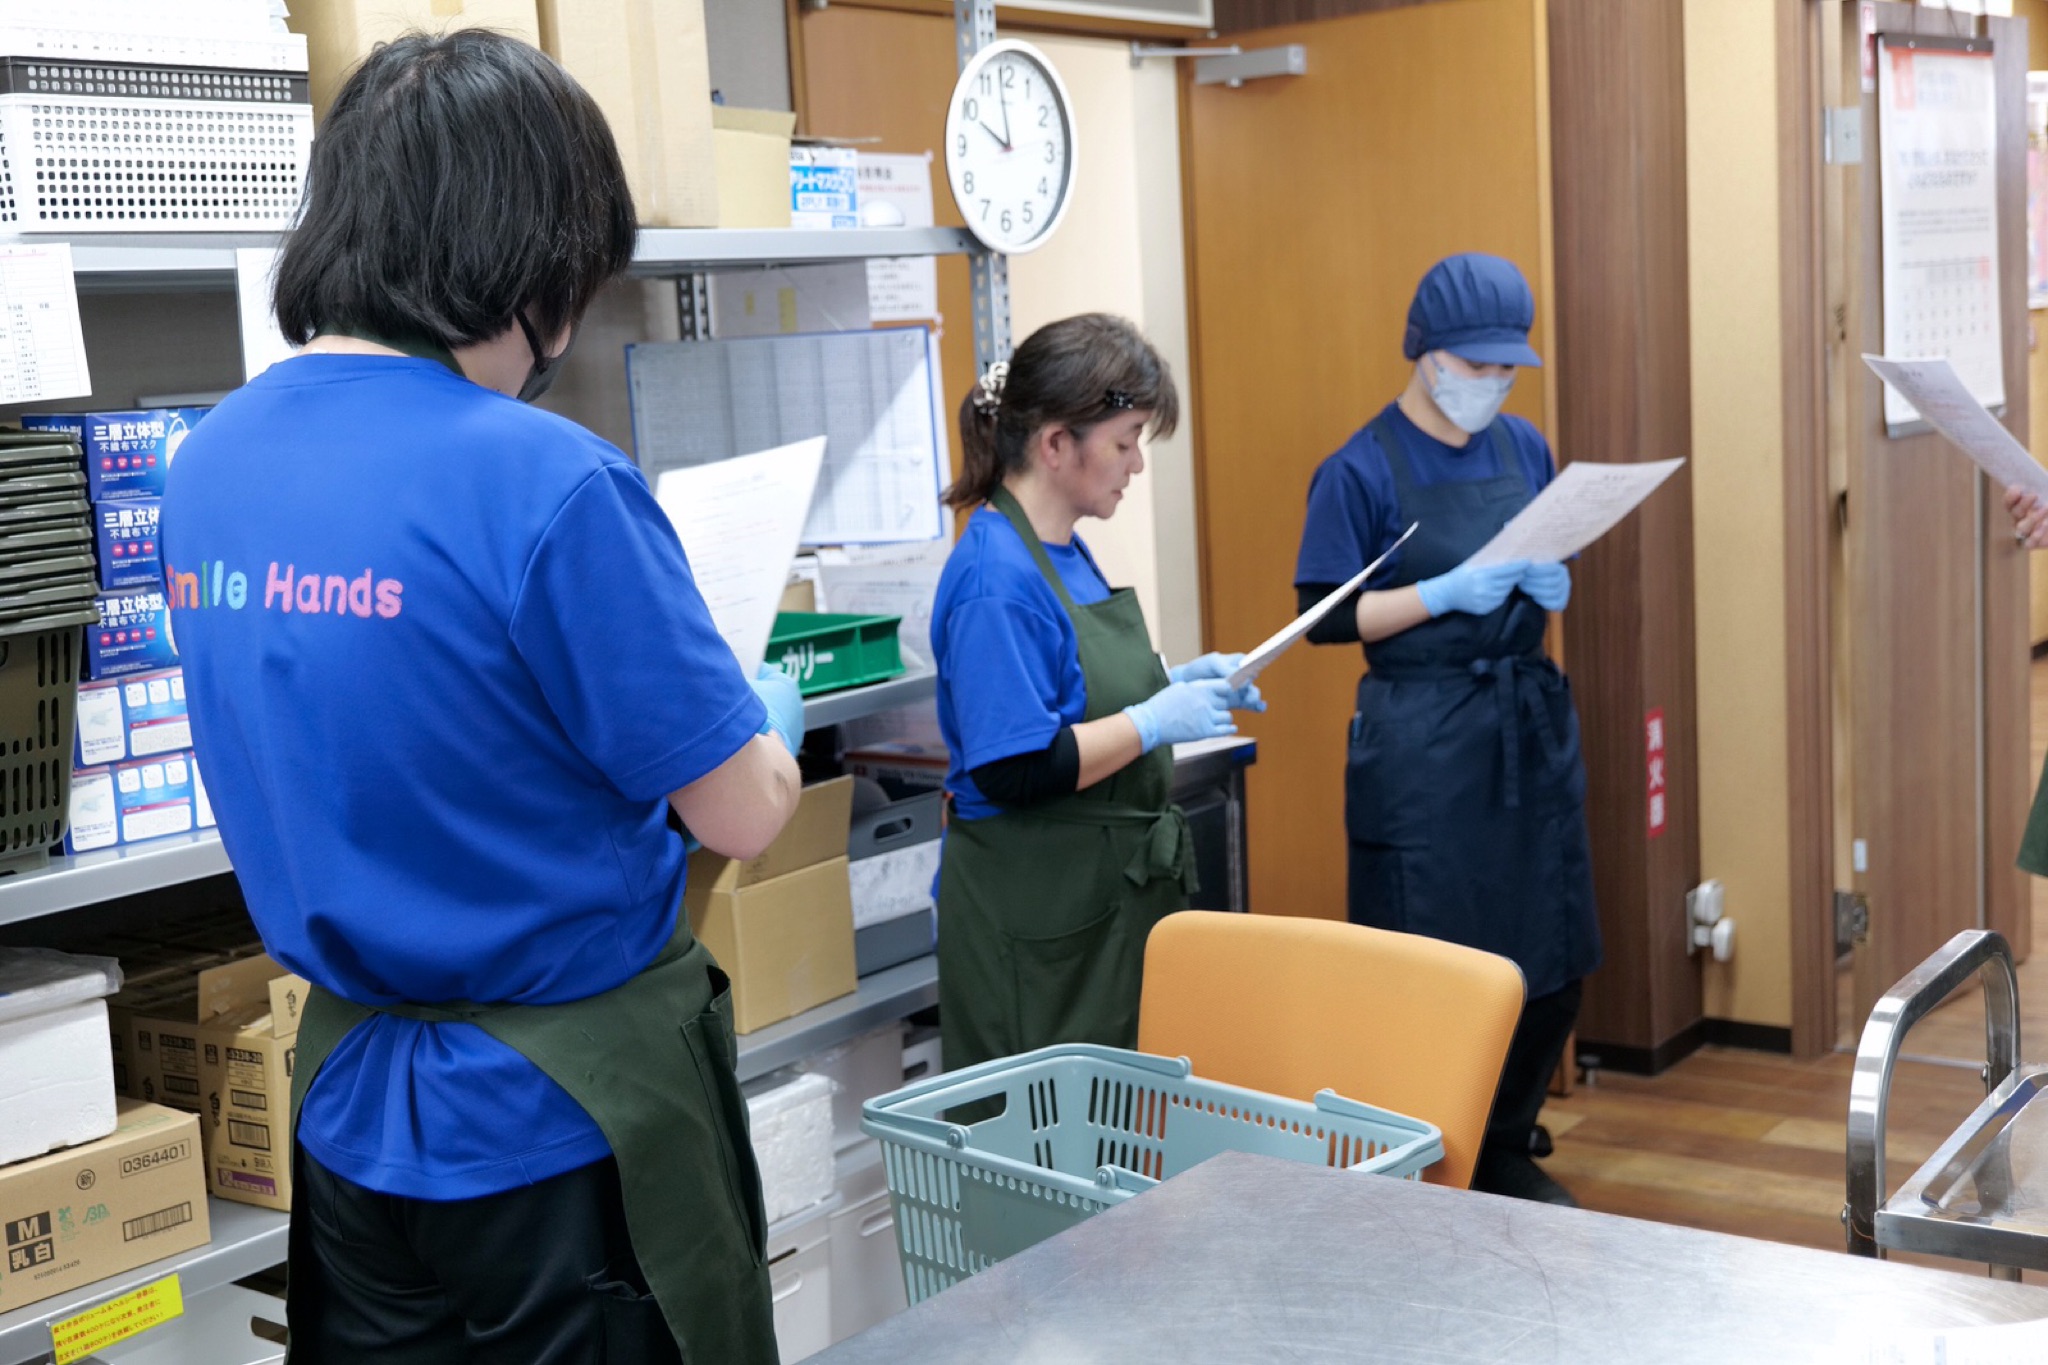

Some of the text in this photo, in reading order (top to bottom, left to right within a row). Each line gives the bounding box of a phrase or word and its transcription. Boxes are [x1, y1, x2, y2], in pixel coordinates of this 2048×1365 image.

[979, 73, 992, 96] 11
[962, 97, 978, 121] 10
[1038, 105, 1049, 128] 2
[957, 134, 968, 157] 9
[1044, 142, 1055, 164] 3
[963, 171, 974, 194] 8
[1037, 176, 1048, 196] 4
[980, 199, 991, 221] 7
[1000, 210, 1012, 232] 6
[1022, 201, 1033, 224] 5
[93, 421, 165, 441] 三層立体型
[100, 440, 156, 453] 不織布マスク
[264, 561, 404, 619] Hands
[123, 1144, 187, 1174] 0364401
[17, 1215, 42, 1242] M
